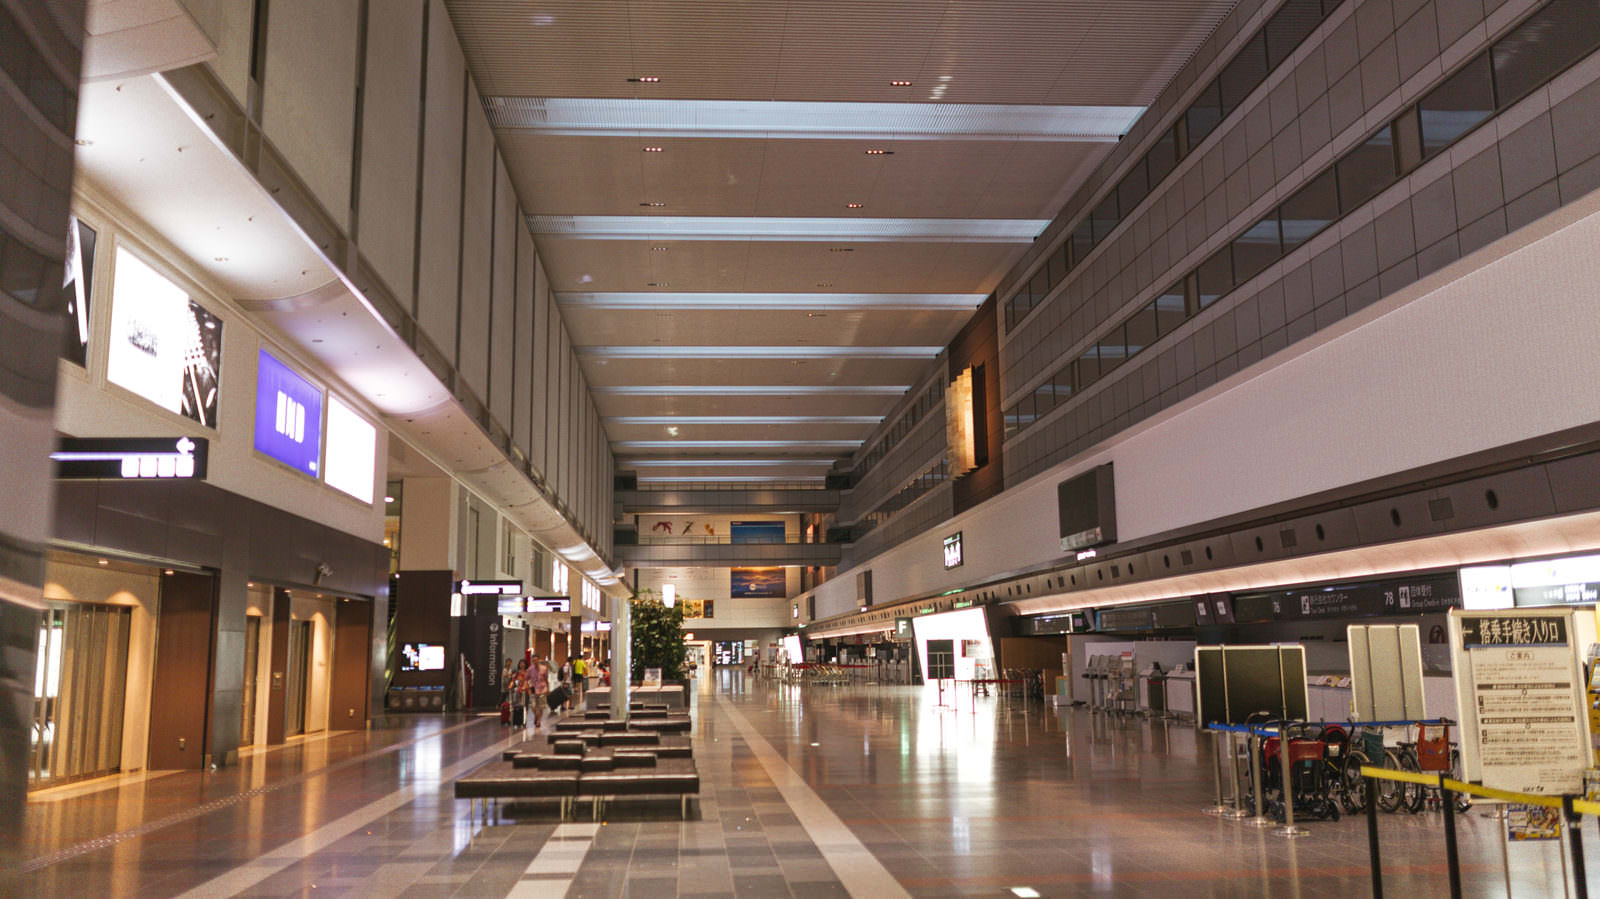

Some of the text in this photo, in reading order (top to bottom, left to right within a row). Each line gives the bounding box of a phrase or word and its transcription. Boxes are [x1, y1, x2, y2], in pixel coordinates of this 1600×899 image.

[1384, 592, 1394, 606] 78
[899, 620, 908, 635] F
[1480, 619, 1559, 644] 搭乗手続き入り口
[488, 633, 498, 686] Information
